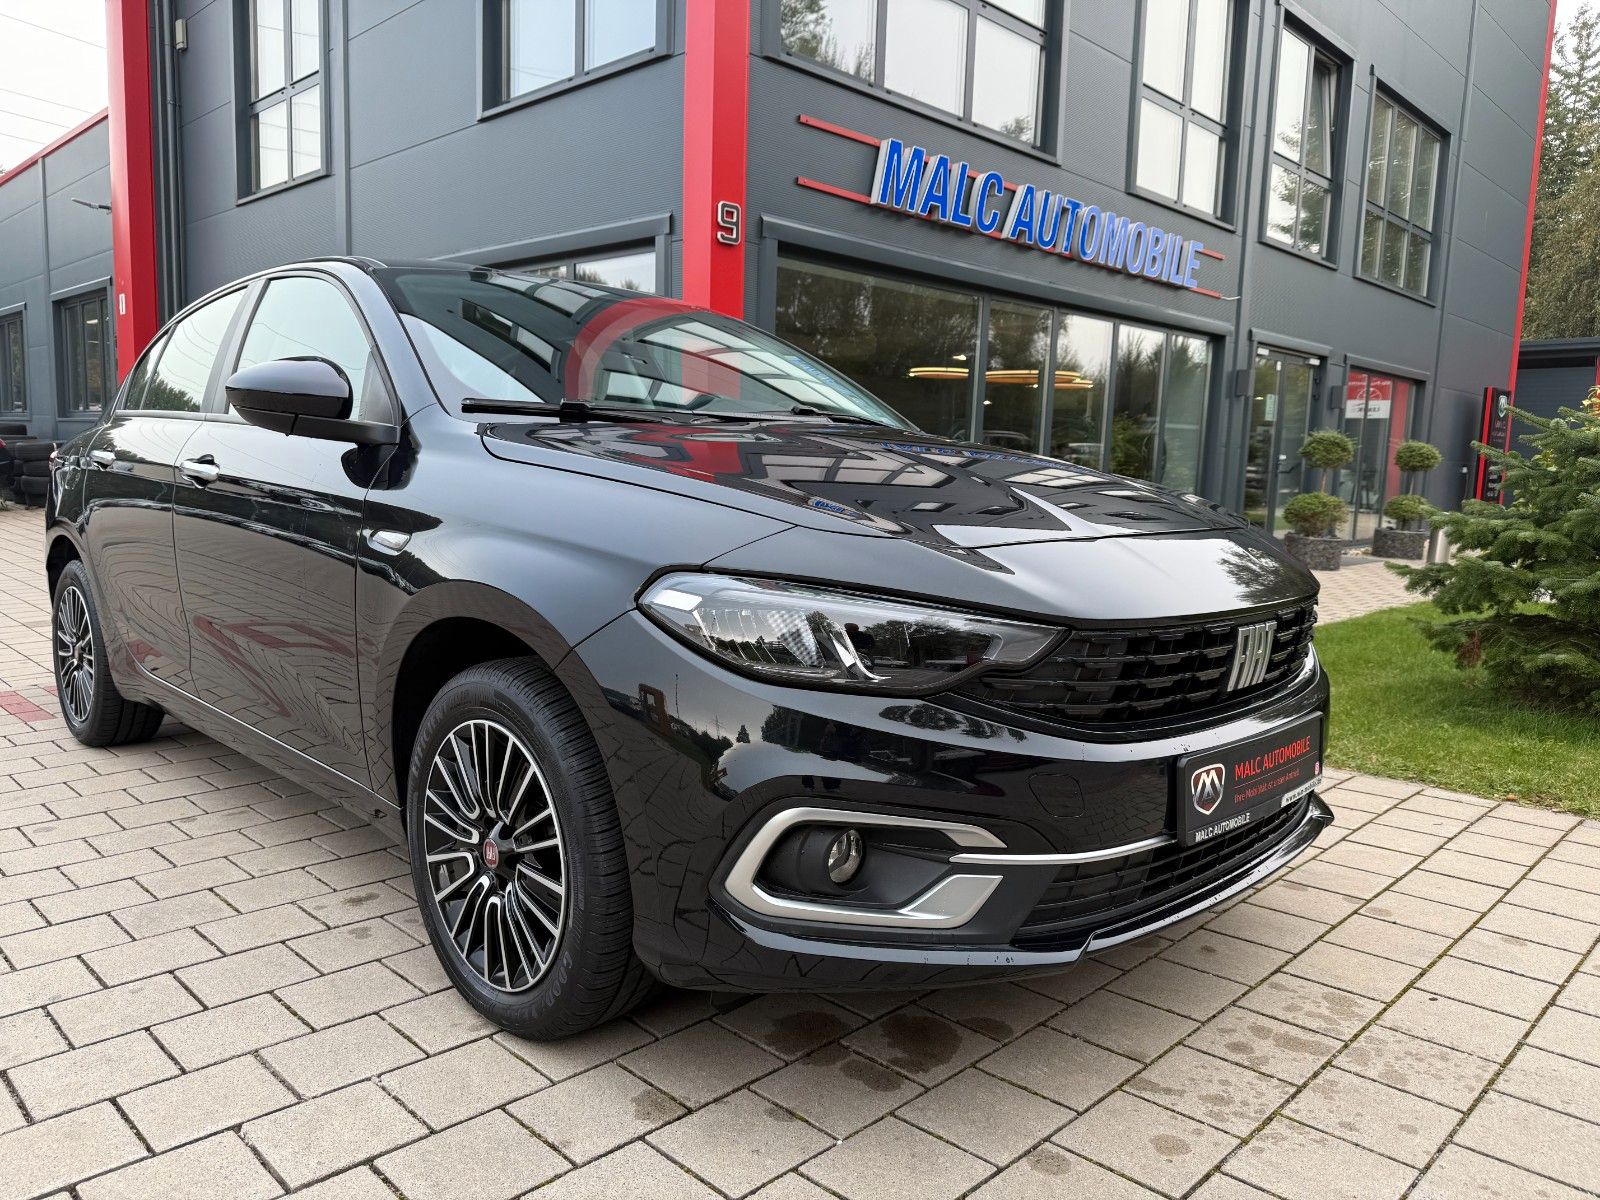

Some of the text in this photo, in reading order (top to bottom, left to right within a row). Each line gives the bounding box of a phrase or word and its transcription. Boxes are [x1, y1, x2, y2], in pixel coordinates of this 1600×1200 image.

[717, 201, 741, 245] 9
[872, 137, 1204, 290] MALC AUTOMOBILE
[1227, 620, 1277, 692] FIAT
[1234, 756, 1261, 781] MALC
[1263, 735, 1311, 770] AUTOMOBILE
[1195, 813, 1250, 843] MALC AUTOMOBILE
